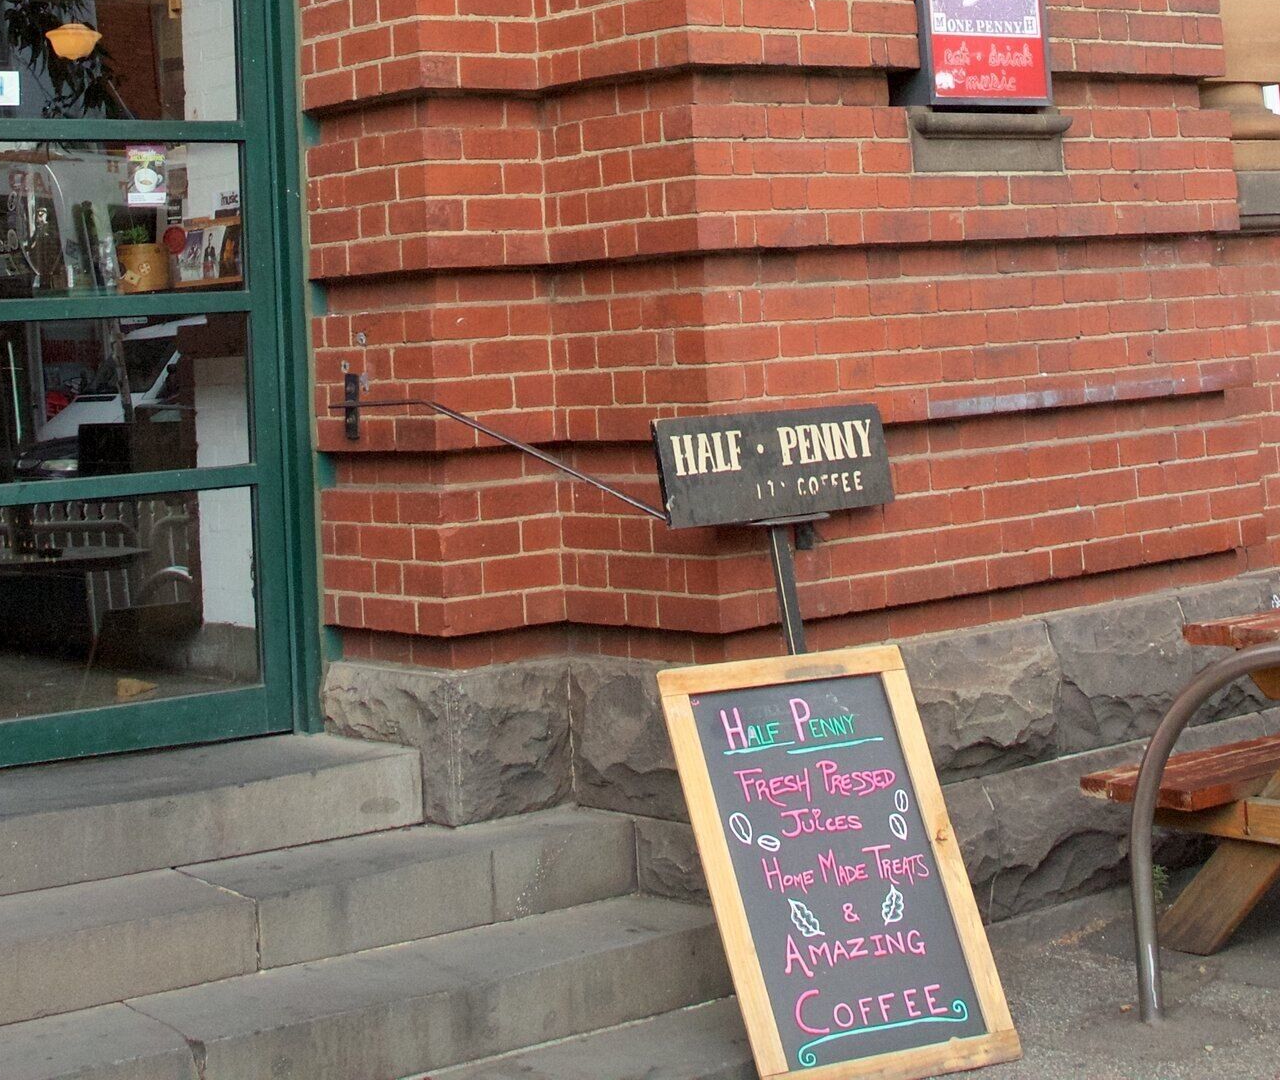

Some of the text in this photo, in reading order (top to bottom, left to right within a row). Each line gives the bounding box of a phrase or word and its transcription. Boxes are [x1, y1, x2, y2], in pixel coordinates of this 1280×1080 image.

[947, 18, 974, 32] ONE
[670, 419, 872, 477] HALF PENNY
[720, 698, 856, 750] HALF PENNY
[733, 759, 896, 807] FRESH PRESSED
[761, 844, 930, 894] HOME MADE TREATS
[842, 902, 860, 922] &
[784, 929, 926, 978] AMAZING
[795, 984, 948, 1035] COFFEE
